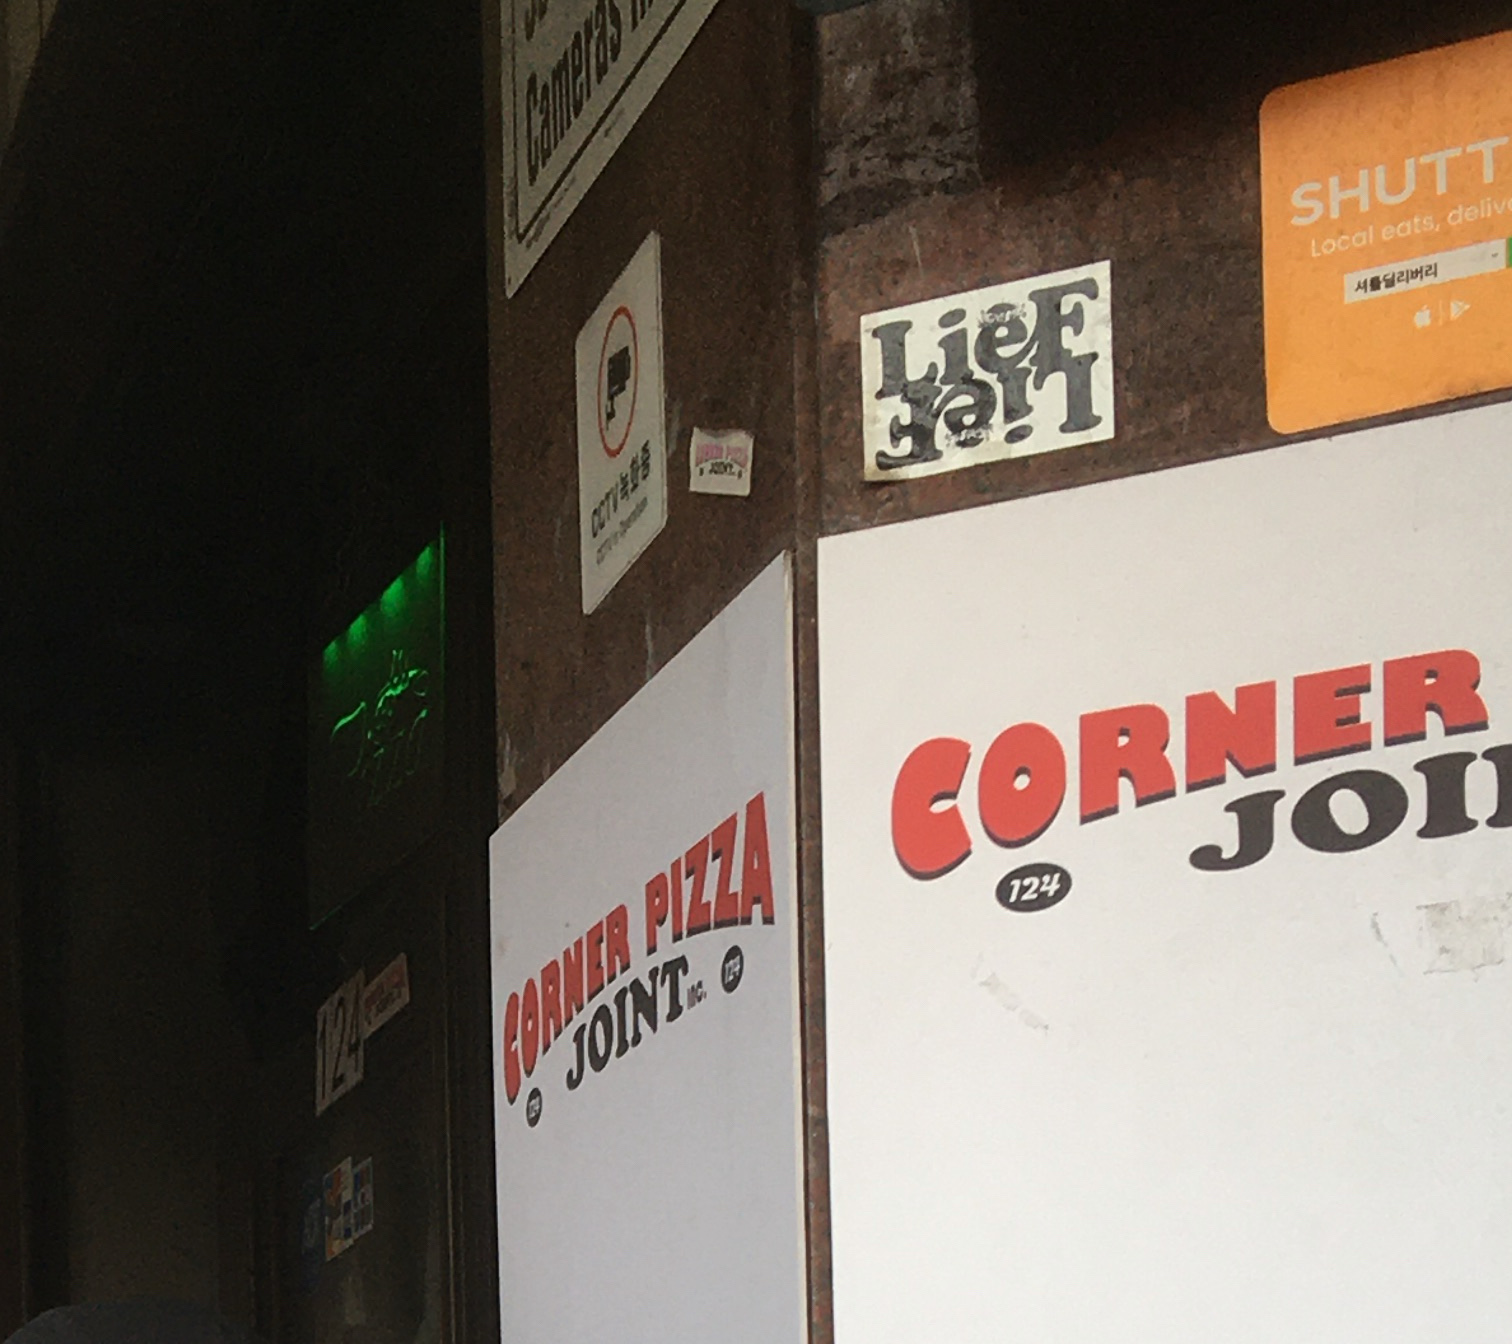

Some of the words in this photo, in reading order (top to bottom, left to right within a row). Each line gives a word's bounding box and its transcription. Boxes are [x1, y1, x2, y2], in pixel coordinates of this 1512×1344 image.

[526, 0, 622, 187] Cameras
[1290, 136, 1510, 227] SHUTT
[1311, 226, 1374, 257] Local
[1381, 214, 1441, 240] eats,
[591, 479, 619, 539] CCTV
[890, 648, 1489, 881] CORNER
[1189, 743, 1512, 871] JOI
[503, 904, 631, 1106] CORNER
[645, 791, 775, 957] PIZZA
[1008, 871, 1062, 904] 124
[318, 982, 361, 1100] 124
[566, 955, 688, 1090] JOINT
